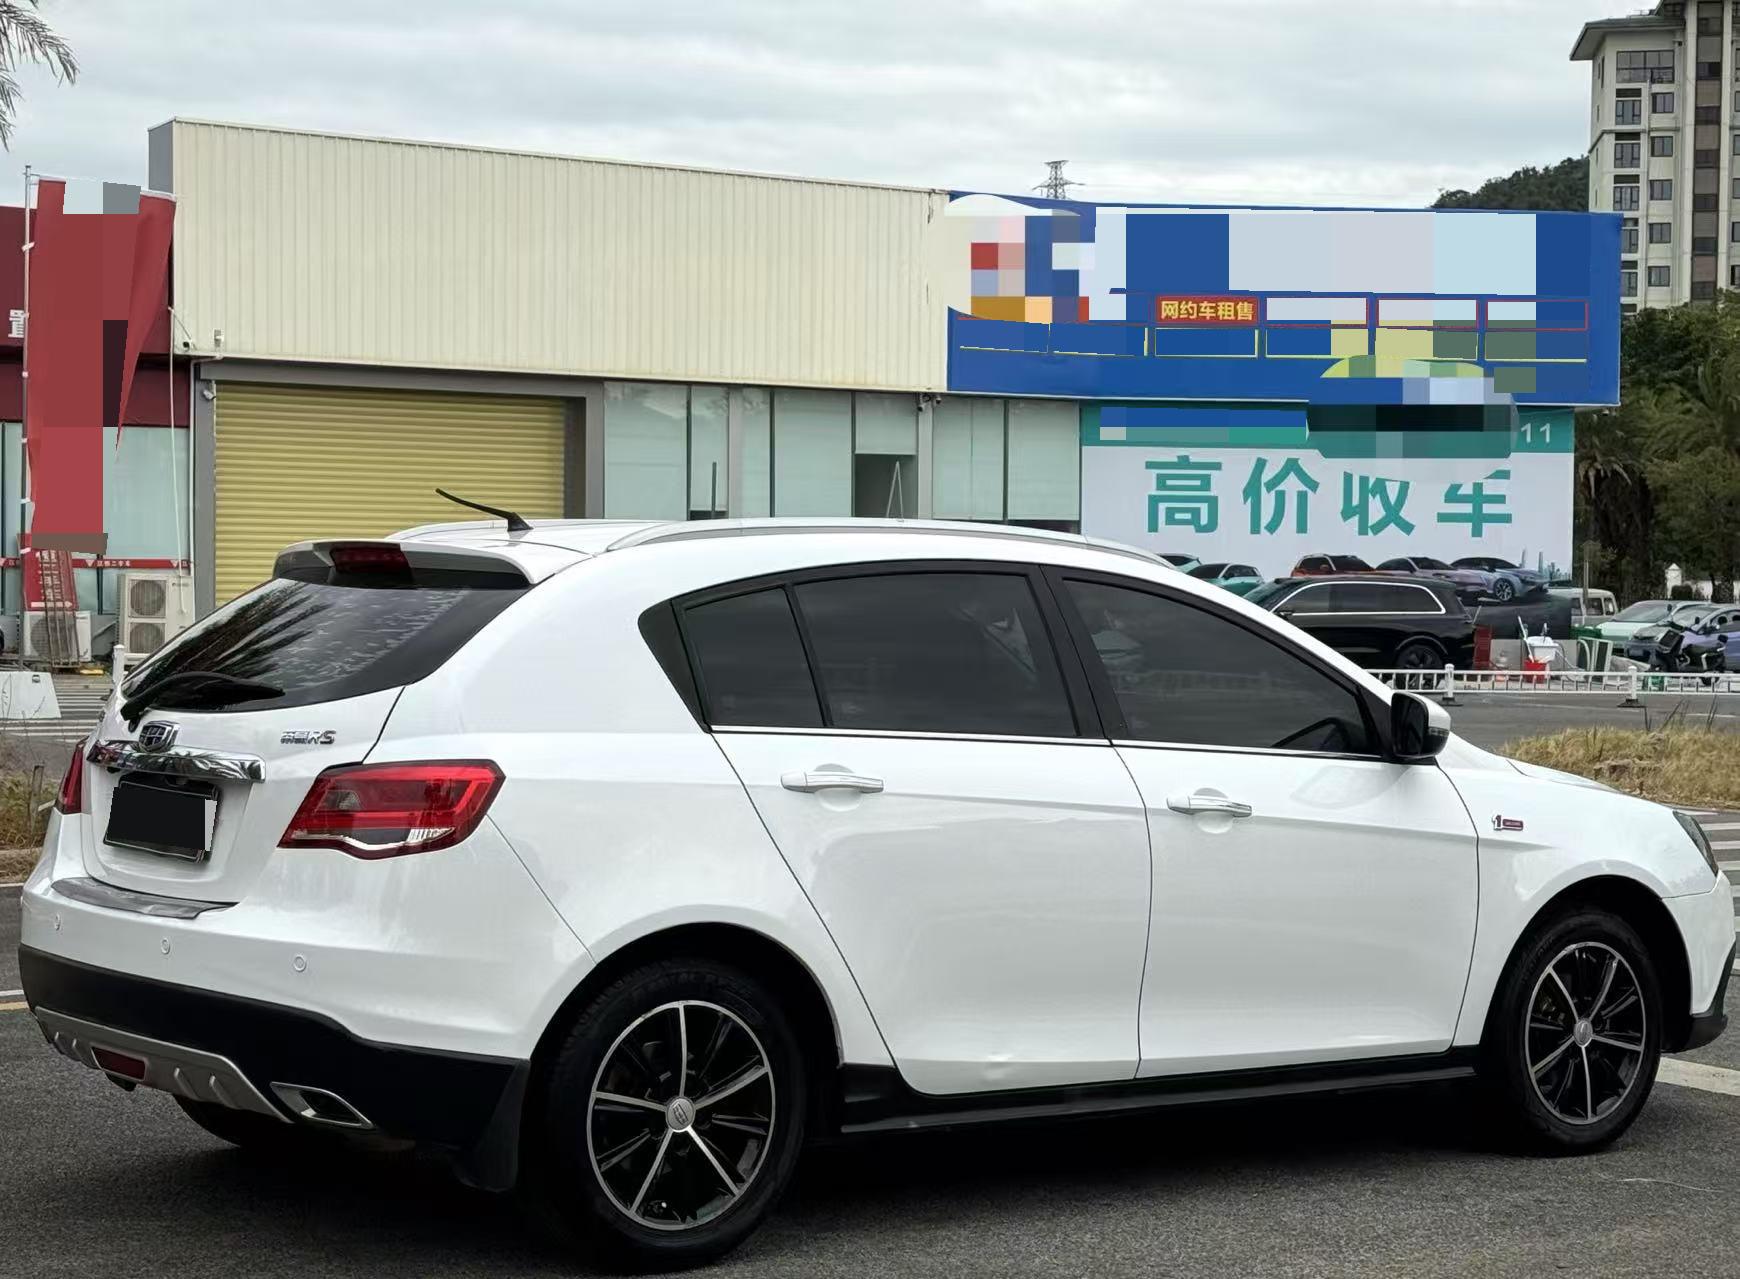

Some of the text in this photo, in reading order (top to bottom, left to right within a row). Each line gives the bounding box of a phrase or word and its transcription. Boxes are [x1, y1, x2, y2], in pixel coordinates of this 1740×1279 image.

[1161, 300, 1254, 320] 网约车租售
[1521, 422, 1551, 443] 11
[1145, 454, 1513, 537] 高价收车
